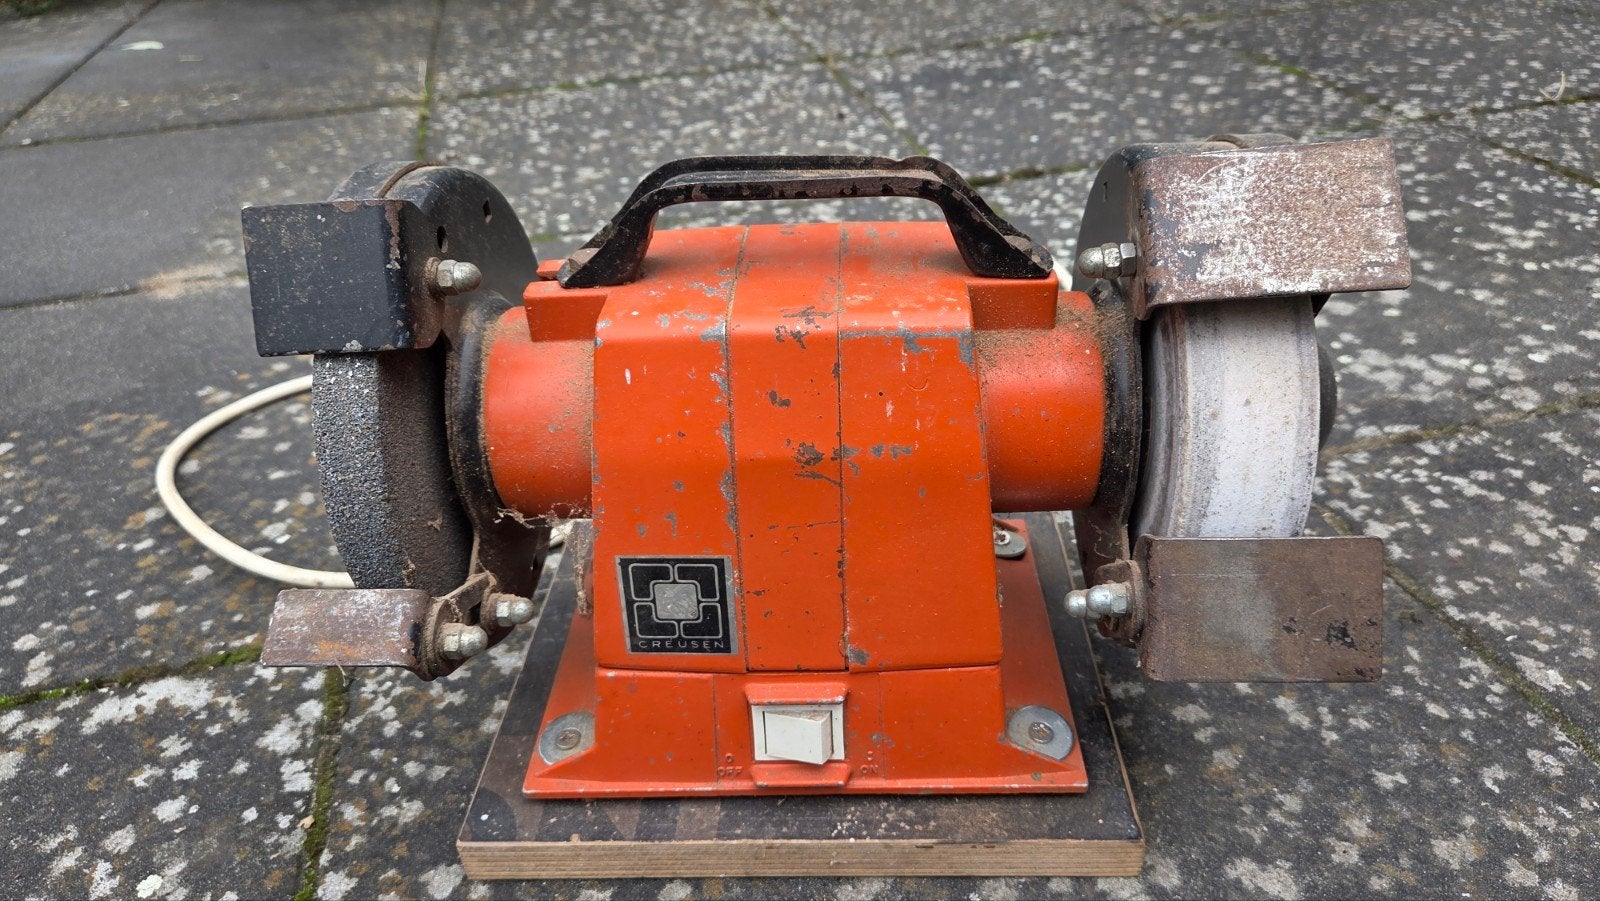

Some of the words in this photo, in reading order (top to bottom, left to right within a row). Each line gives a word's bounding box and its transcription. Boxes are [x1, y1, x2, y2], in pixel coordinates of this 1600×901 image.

[638, 640, 725, 649] CREUSEN
[717, 765, 743, 776] OFF
[860, 764, 879, 775] ON
